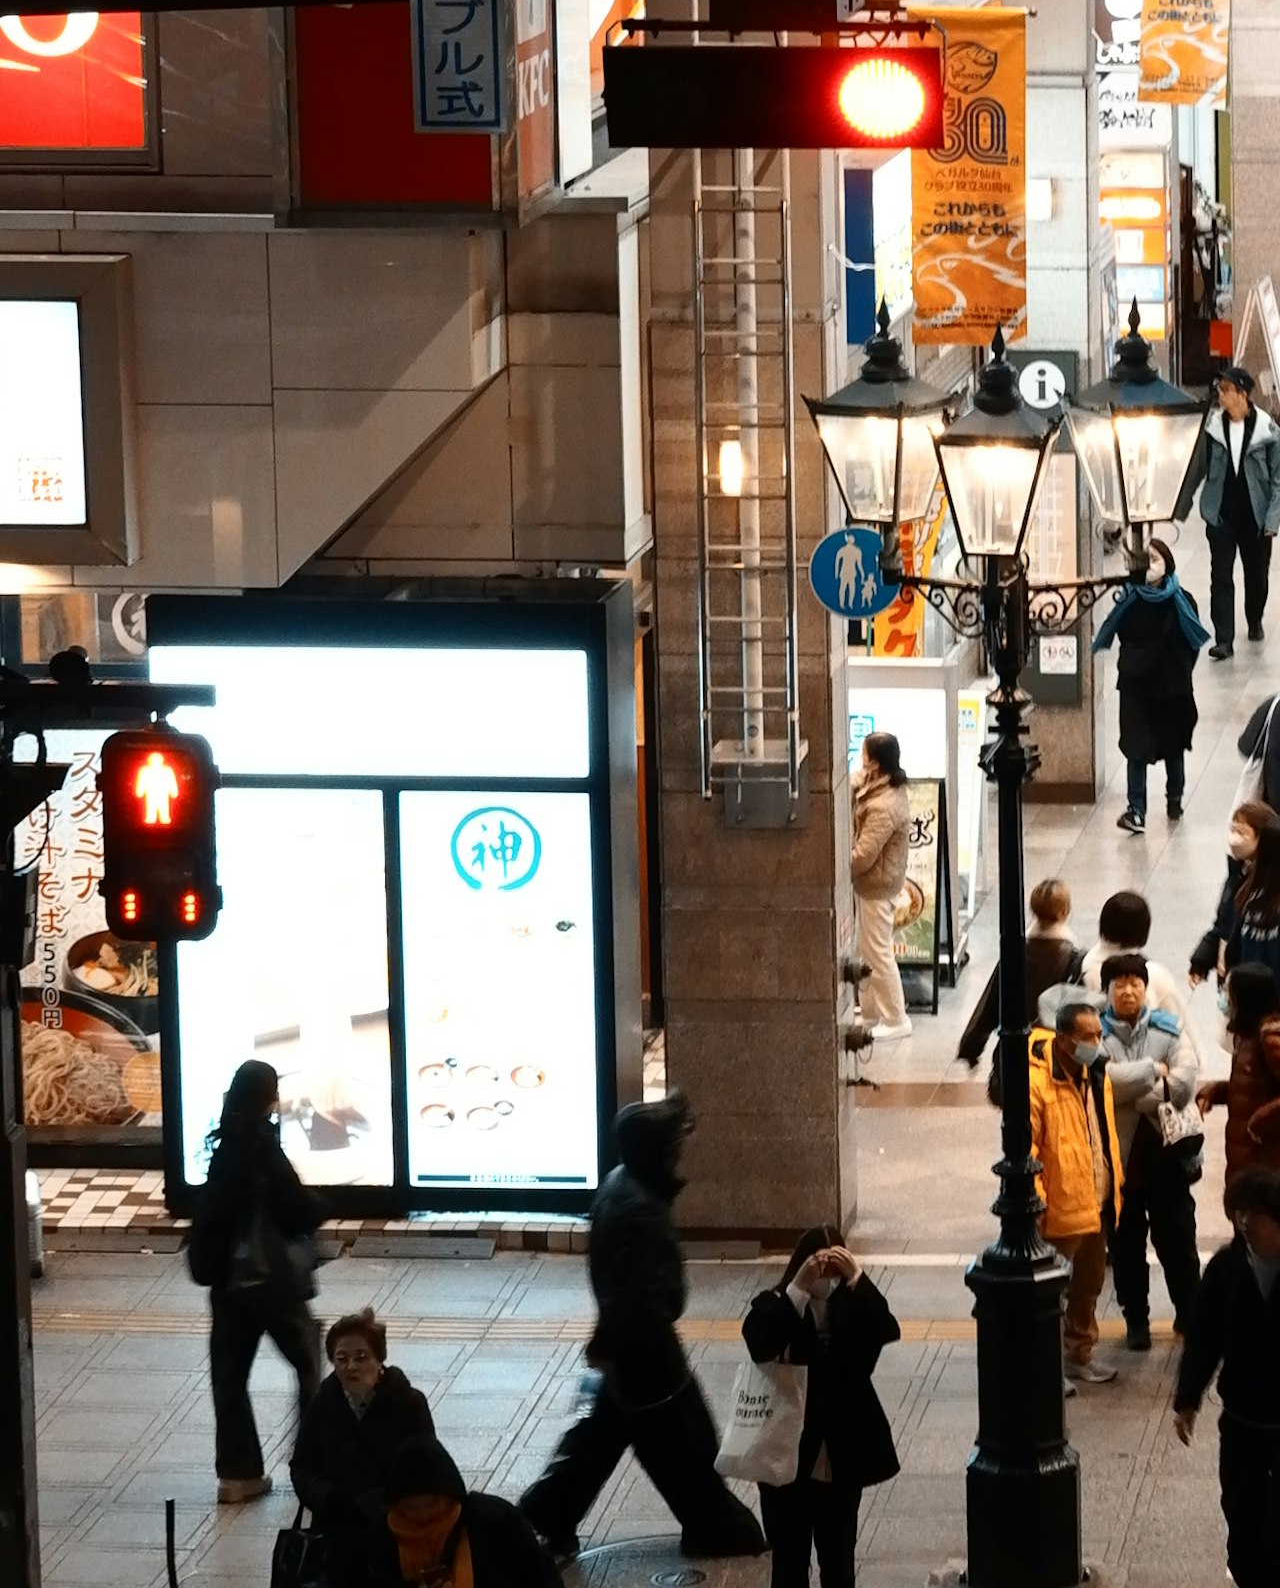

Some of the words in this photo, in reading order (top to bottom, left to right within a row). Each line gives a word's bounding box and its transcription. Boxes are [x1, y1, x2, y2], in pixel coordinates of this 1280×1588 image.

[518, 49, 551, 121] KFC
[933, 200, 1007, 217] これからも
[471, 820, 523, 879] 神
